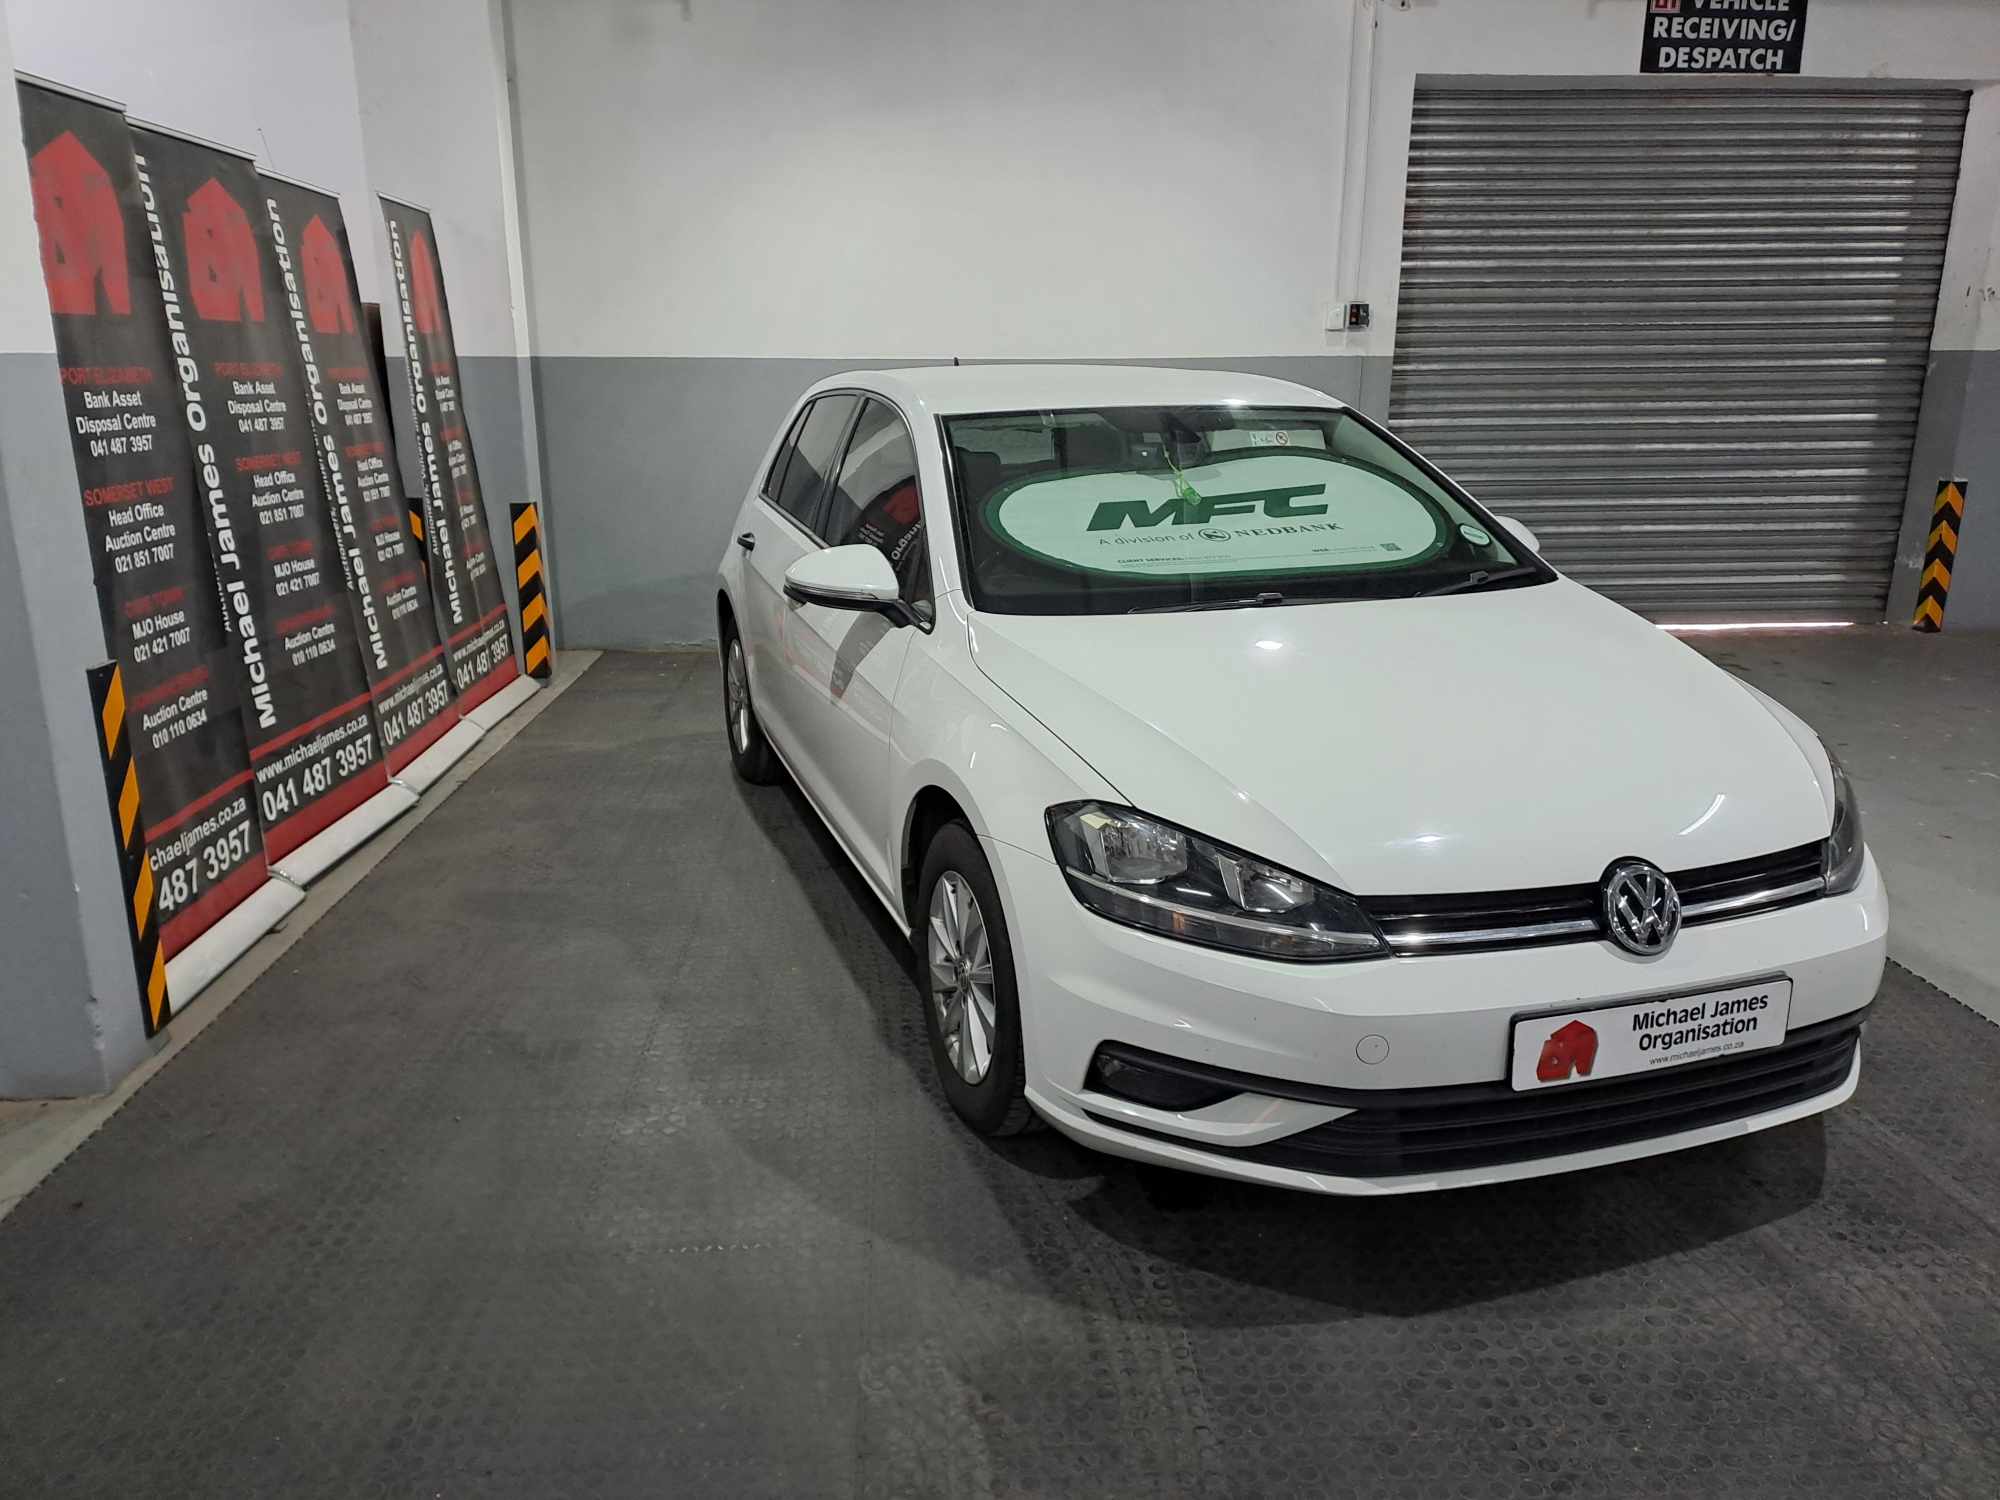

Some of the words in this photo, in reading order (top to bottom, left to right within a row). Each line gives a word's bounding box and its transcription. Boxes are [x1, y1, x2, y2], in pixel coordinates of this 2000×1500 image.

[1653, 16, 1797, 42] RECEIVING/
[1658, 46, 1784, 70] DESPATCH
[266, 198, 328, 425] Organisation
[389, 220, 427, 413] Organisation
[84, 391, 111, 409] Bank
[112, 390, 142, 408] Asset
[232, 380, 255, 395] Bank
[76, 414, 122, 436] Disposal
[123, 413, 157, 430] Centre
[227, 400, 263, 416] Disposal
[90, 439, 109, 457] 041
[110, 437, 127, 455] 487
[129, 434, 153, 453] 3957
[253, 472, 274, 488] Head
[421, 421, 445, 512] James
[251, 491, 281, 508] Auction
[323, 434, 357, 539] James
[108, 506, 134, 528] Head
[134, 502, 165, 522] Office
[197, 443, 241, 571] James
[259, 509, 274, 526] 021
[273, 506, 288, 522] 851
[1086, 483, 1329, 532] MFC
[105, 531, 143, 553] Auction
[143, 523, 176, 543] Centre
[1099, 537, 1111, 546] A
[1113, 534, 1177, 546] division
[1178, 531, 1195, 542] of
[1235, 522, 1345, 538] NEDBANK
[115, 554, 133, 573] 021
[133, 548, 152, 568] 851
[151, 543, 175, 563] 7007
[273, 561, 291, 578] MJO
[290, 557, 315, 574] House
[436, 519, 463, 625] Michael
[132, 618, 154, 641] MJO
[154, 610, 185, 631] House
[347, 547, 389, 670] Michael
[133, 643, 152, 664] 021
[151, 635, 169, 656] 421
[168, 626, 191, 649] 7007
[225, 580, 277, 729] Michael
[456, 660, 476, 690] 041
[490, 633, 510, 664] 3957
[142, 702, 178, 731] Auction
[178, 688, 208, 712] Centre
[383, 711, 407, 746] 041
[406, 695, 426, 729] 487
[424, 679, 449, 715] 3957
[152, 730, 170, 750] 010
[169, 723, 187, 742] 110
[256, 713, 369, 785] www.michaeljames.co.za
[262, 777, 299, 822] 041
[302, 756, 333, 797] 487
[335, 732, 374, 778] 3957
[150, 796, 248, 872] chaeljames.co.za
[158, 856, 199, 912] 487
[202, 819, 252, 880] 3957
[1632, 1002, 1706, 1032] Michael
[1710, 994, 1769, 1019] James
[1638, 1016, 1758, 1051] Organisation
